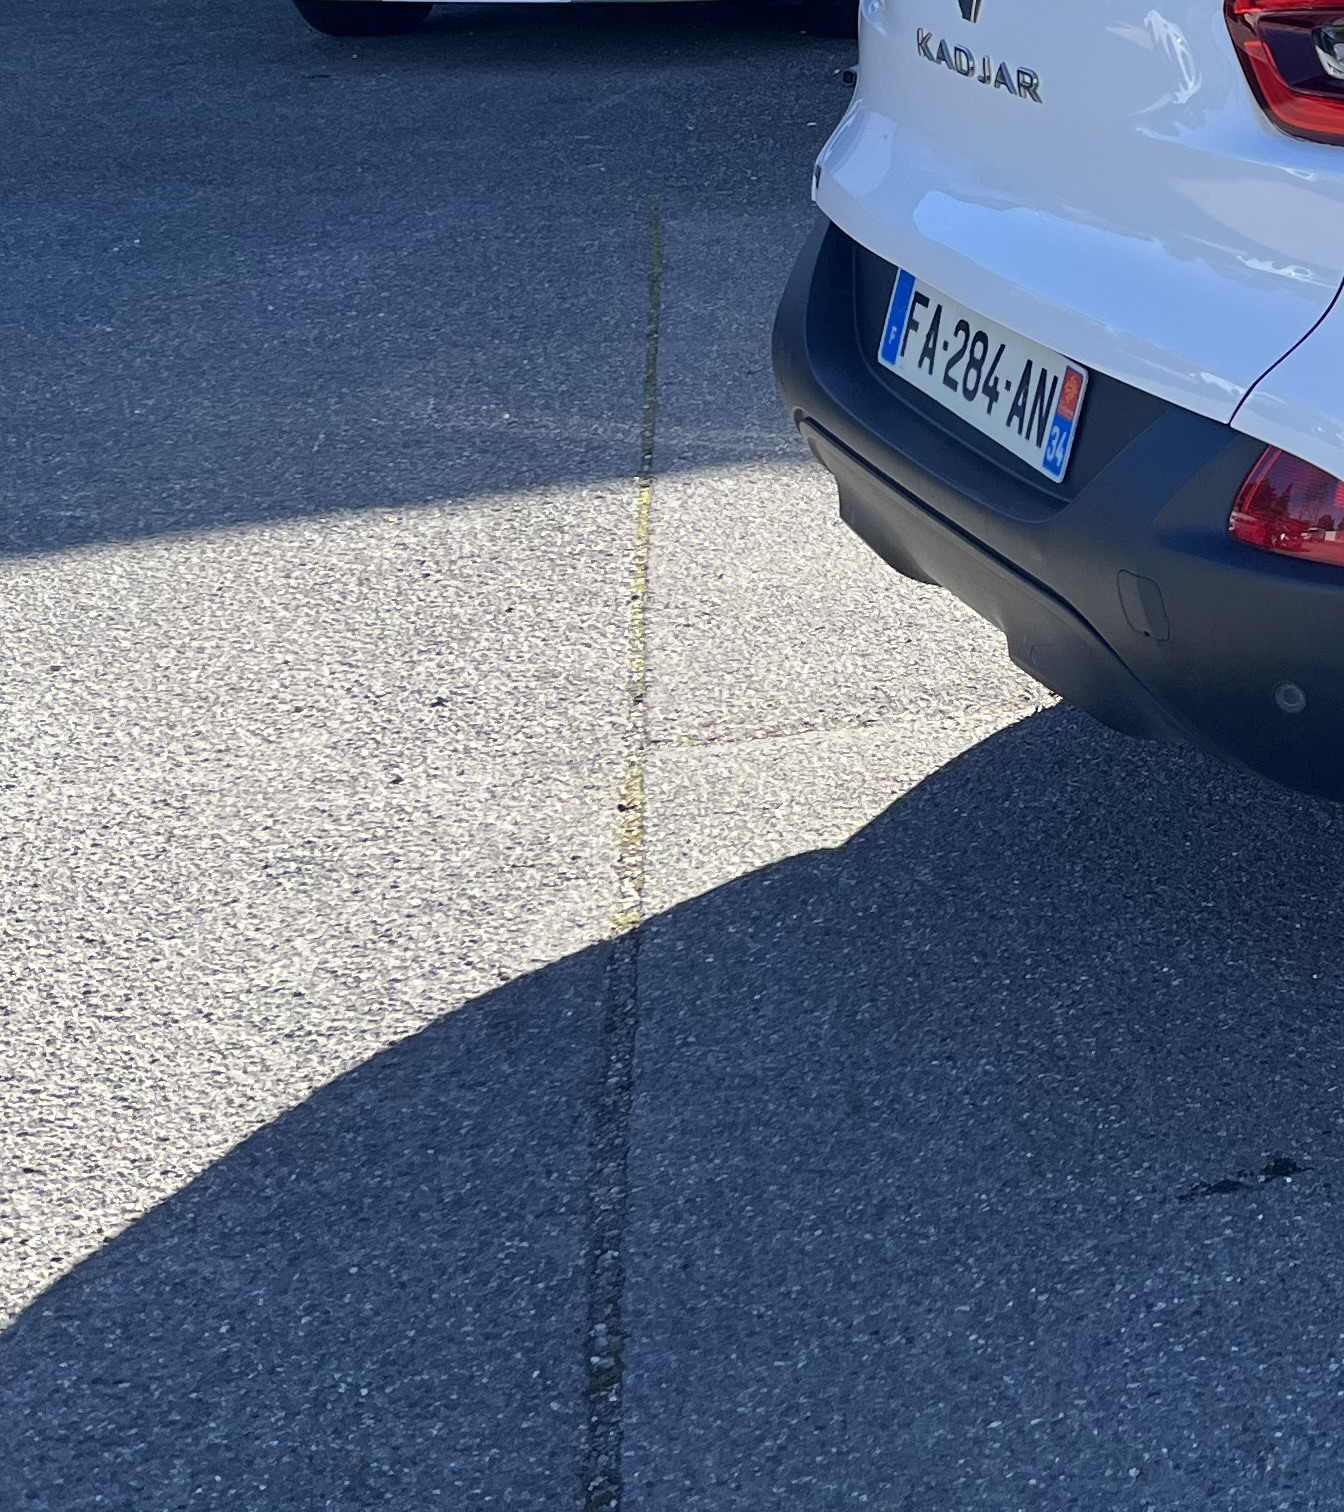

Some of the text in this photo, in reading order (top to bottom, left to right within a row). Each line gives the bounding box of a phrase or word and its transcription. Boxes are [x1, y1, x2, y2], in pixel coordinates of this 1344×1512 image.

[916, 27, 1042, 104] KADJAR
[888, 325, 897, 345] F
[900, 290, 1058, 448] FA-284-AN
[1046, 425, 1067, 467] 34
